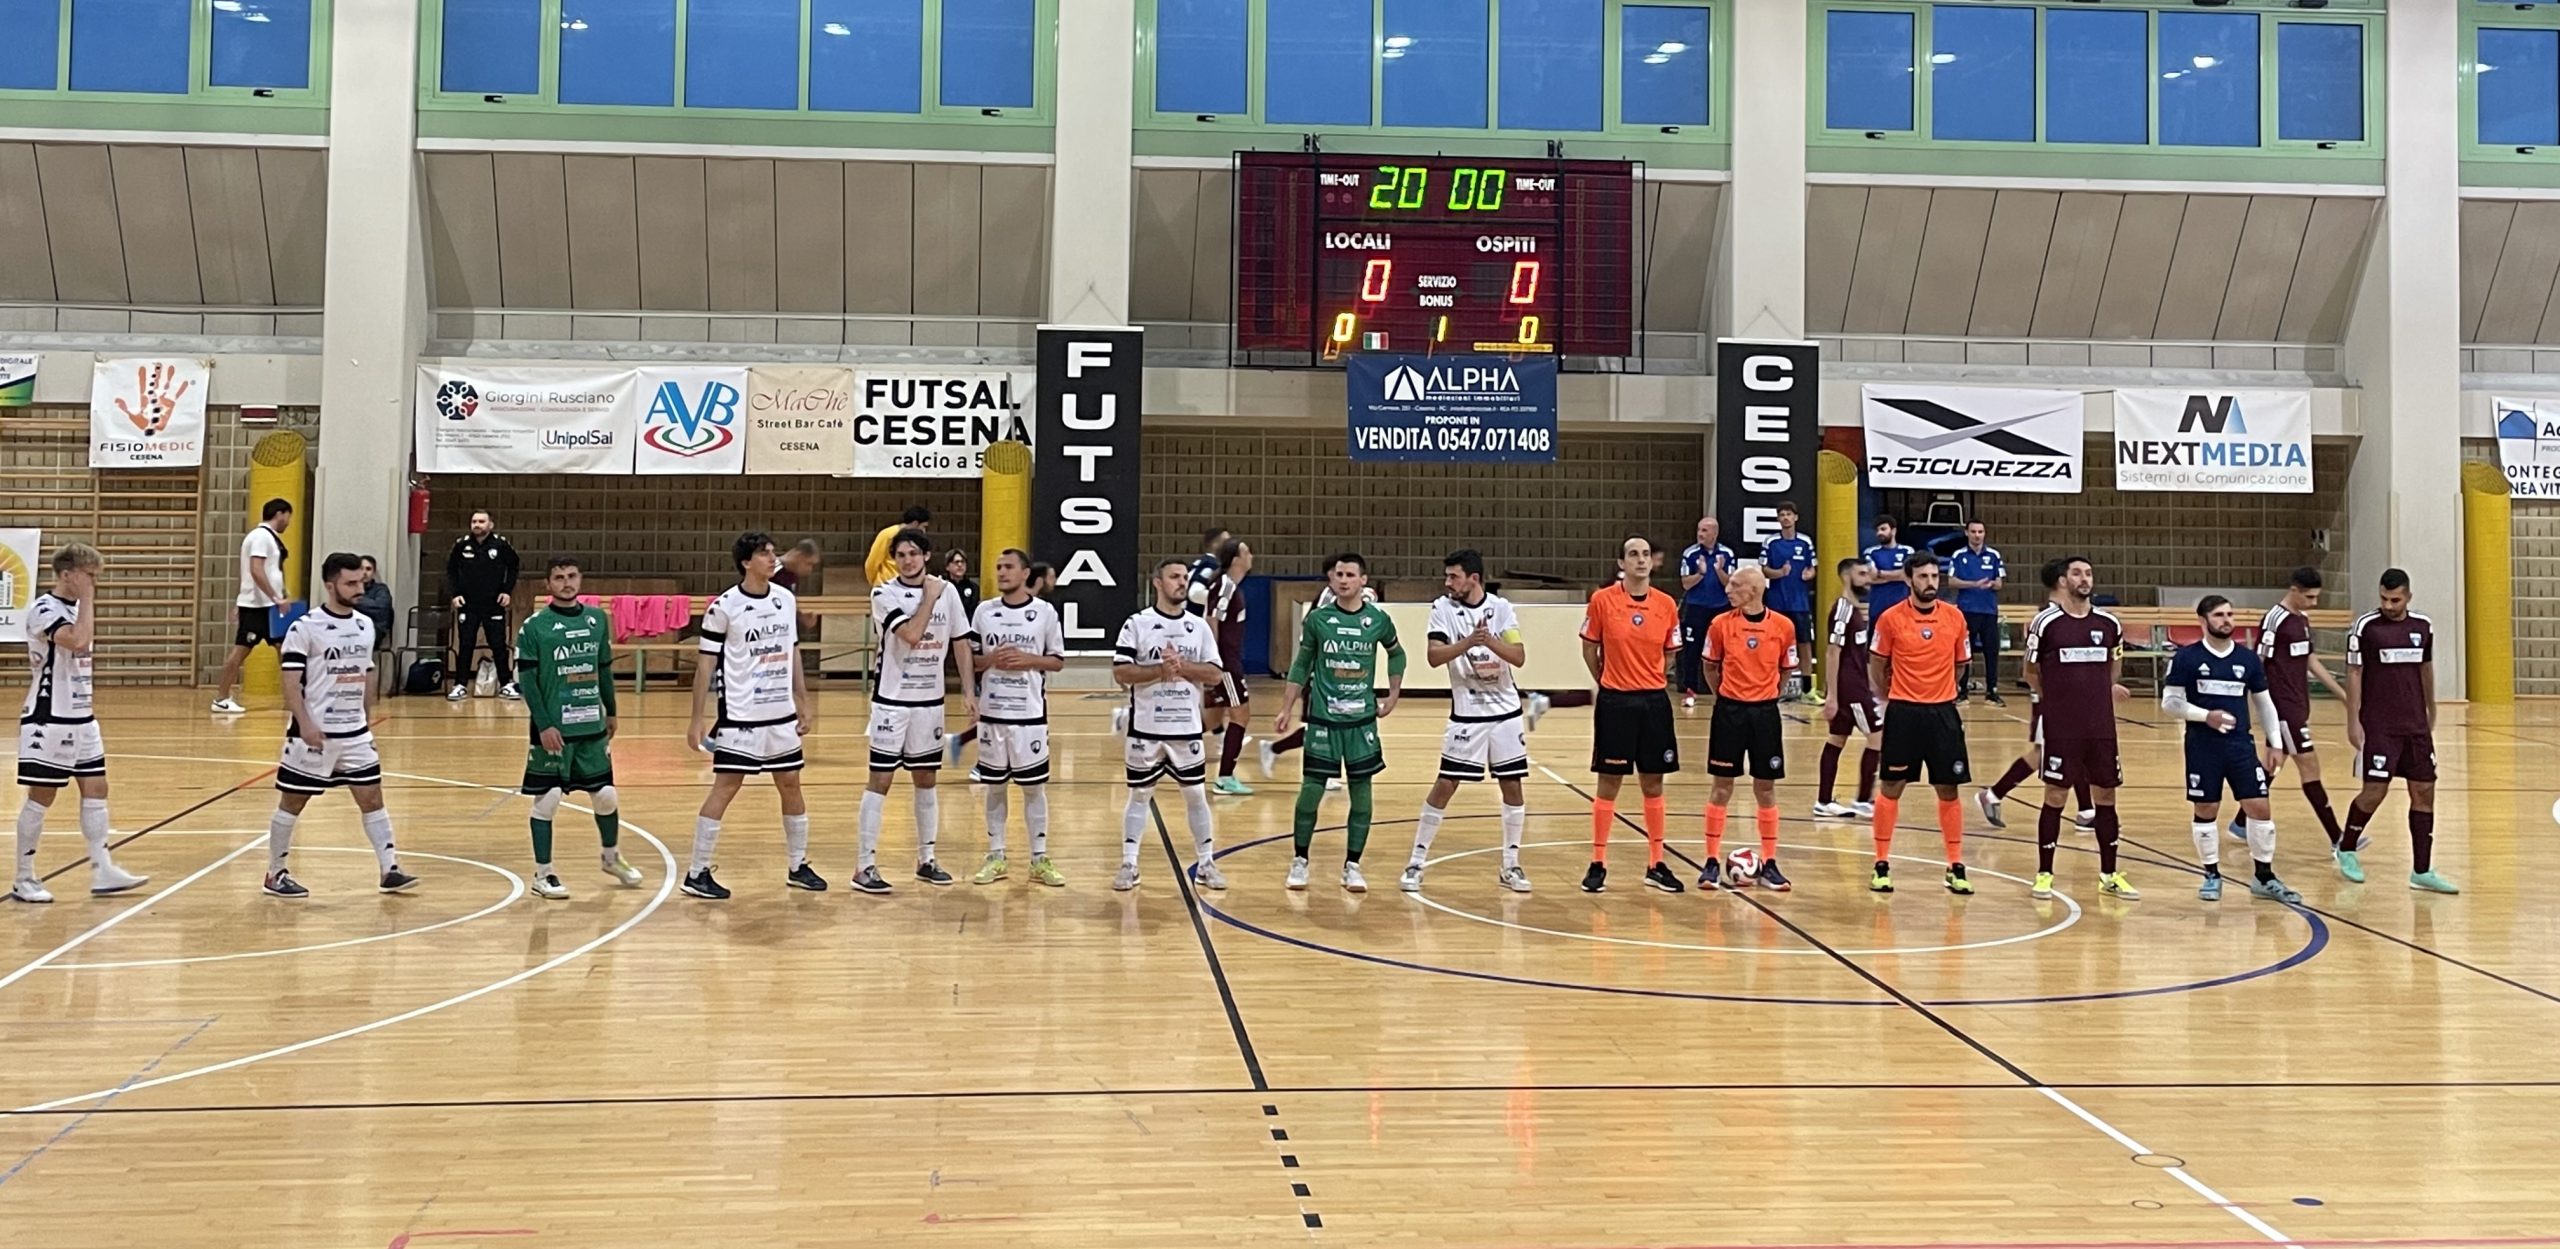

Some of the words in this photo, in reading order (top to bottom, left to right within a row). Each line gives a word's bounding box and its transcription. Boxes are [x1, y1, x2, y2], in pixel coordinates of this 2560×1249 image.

[1320, 173, 1359, 187] TIME-OUT
[1369, 165, 1427, 208] 20
[1448, 168, 1505, 210] 00
[1516, 178, 1555, 192] TIME-OUT
[1325, 231, 1391, 250] LOCALI
[1476, 236, 1536, 254] OSPITI
[1361, 259, 1392, 302] 0
[1417, 275, 1457, 290] SERVIZIO
[1509, 261, 1540, 304] 0
[1419, 295, 1454, 308] BONUS
[1333, 312, 1357, 342] 0
[1518, 316, 1540, 344] 0
[1425, 366, 1520, 391] ALPHA
[485, 390, 543, 405] Giorgini
[549, 391, 615, 404] Rusciano
[866, 379, 1021, 410] FUTSAL
[645, 381, 740, 442] AVB
[1425, 416, 1468, 425] PROPONE
[1470, 416, 1480, 425] IN
[757, 419, 791, 428] Street
[795, 419, 816, 428] Bar
[853, 415, 1033, 446] CESENA
[100, 442, 195, 452] FISIOMEDIC
[546, 430, 613, 449] UnipolSai
[780, 442, 820, 451] CESENA
[1355, 427, 1433, 450] VENDITA
[1437, 428, 1550, 451] 0547.071408
[893, 452, 950, 469] calcio
[957, 456, 967, 469] a
[975, 453, 983, 469] 5
[2119, 440, 2307, 467] NEXTMEDIA
[1741, 354, 1794, 588] CESE
[1869, 456, 2073, 479] R.SICUREZZA
[2502, 464, 2560, 479] ONTEG
[2120, 470, 2171, 483] Sistemi
[2176, 472, 2190, 484] di
[2195, 472, 2307, 485] Comunicazione
[1055, 341, 1117, 639] FUTSAL
[1001, 633, 1036, 645] ALPHA
